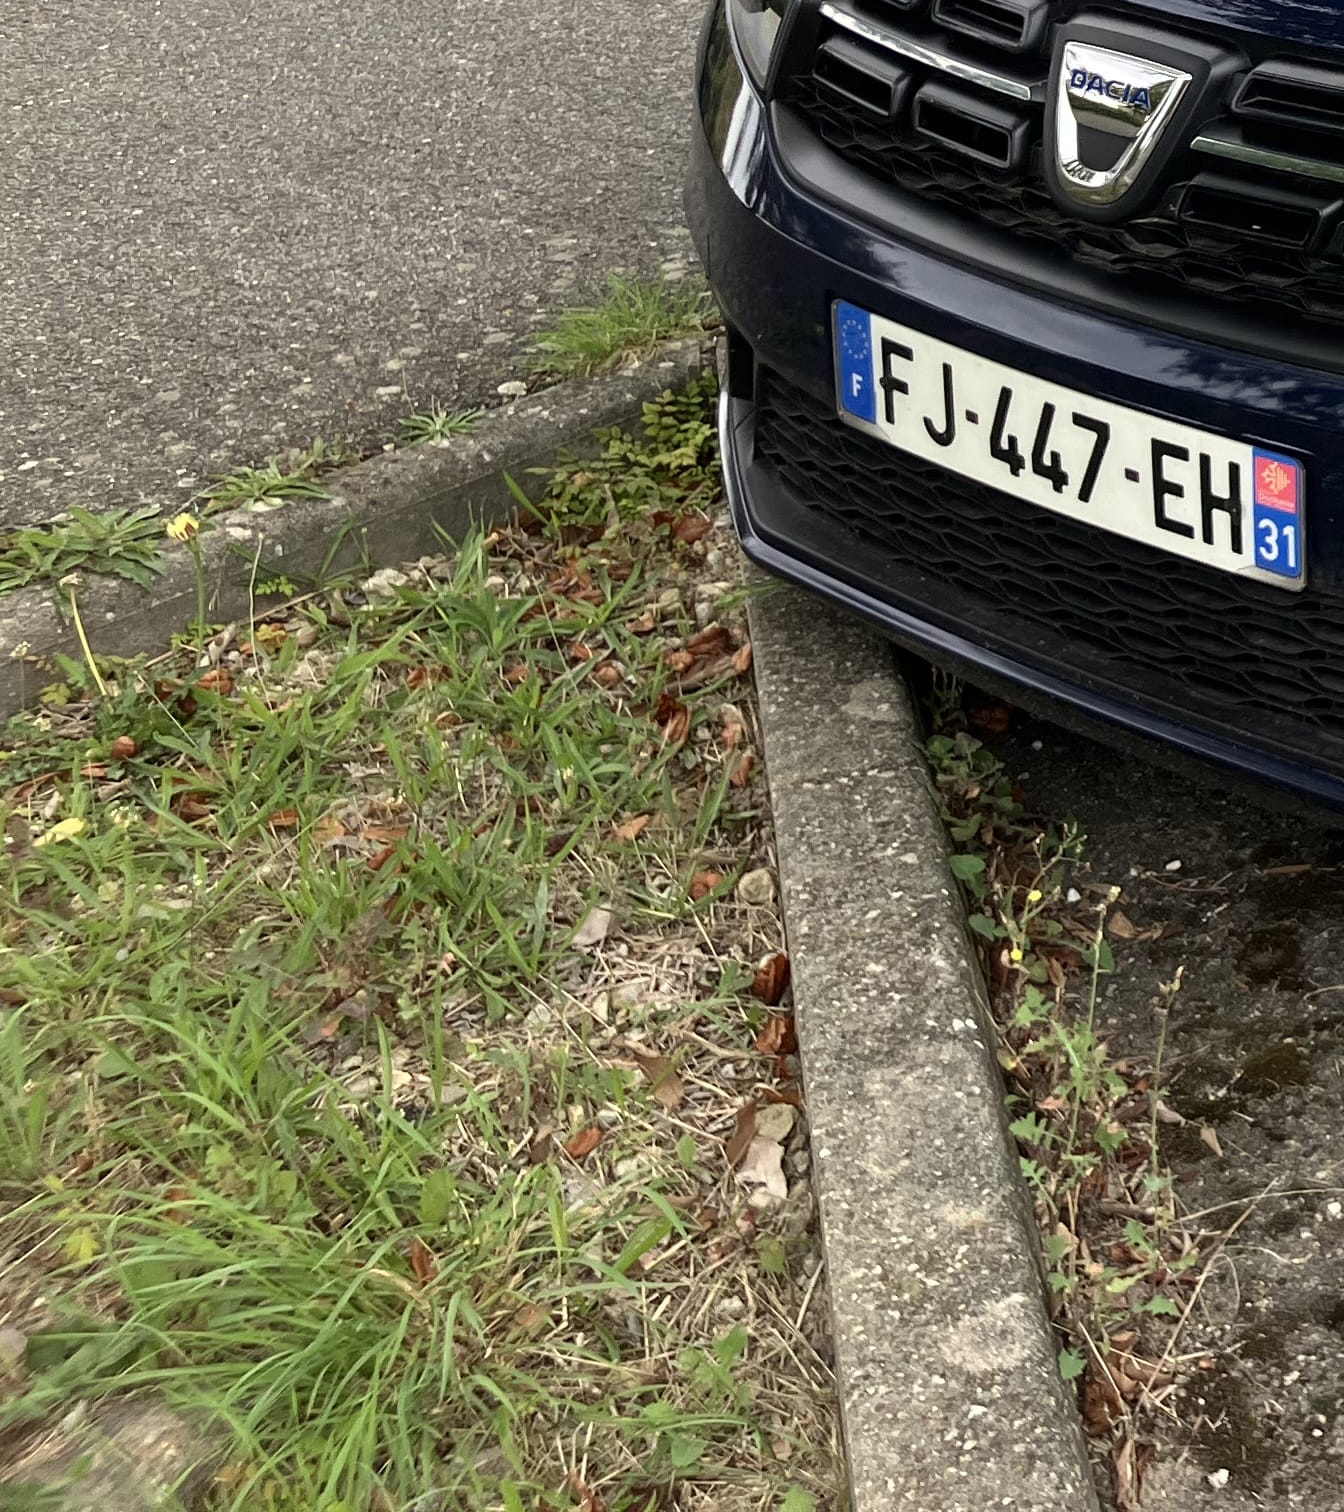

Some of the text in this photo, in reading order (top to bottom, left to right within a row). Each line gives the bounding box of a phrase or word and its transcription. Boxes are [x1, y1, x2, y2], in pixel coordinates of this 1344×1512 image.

[1070, 68, 1151, 109] DACIA
[852, 372, 864, 397] F
[878, 336, 1243, 555] FJ-447-EH
[1258, 518, 1296, 568] 31
